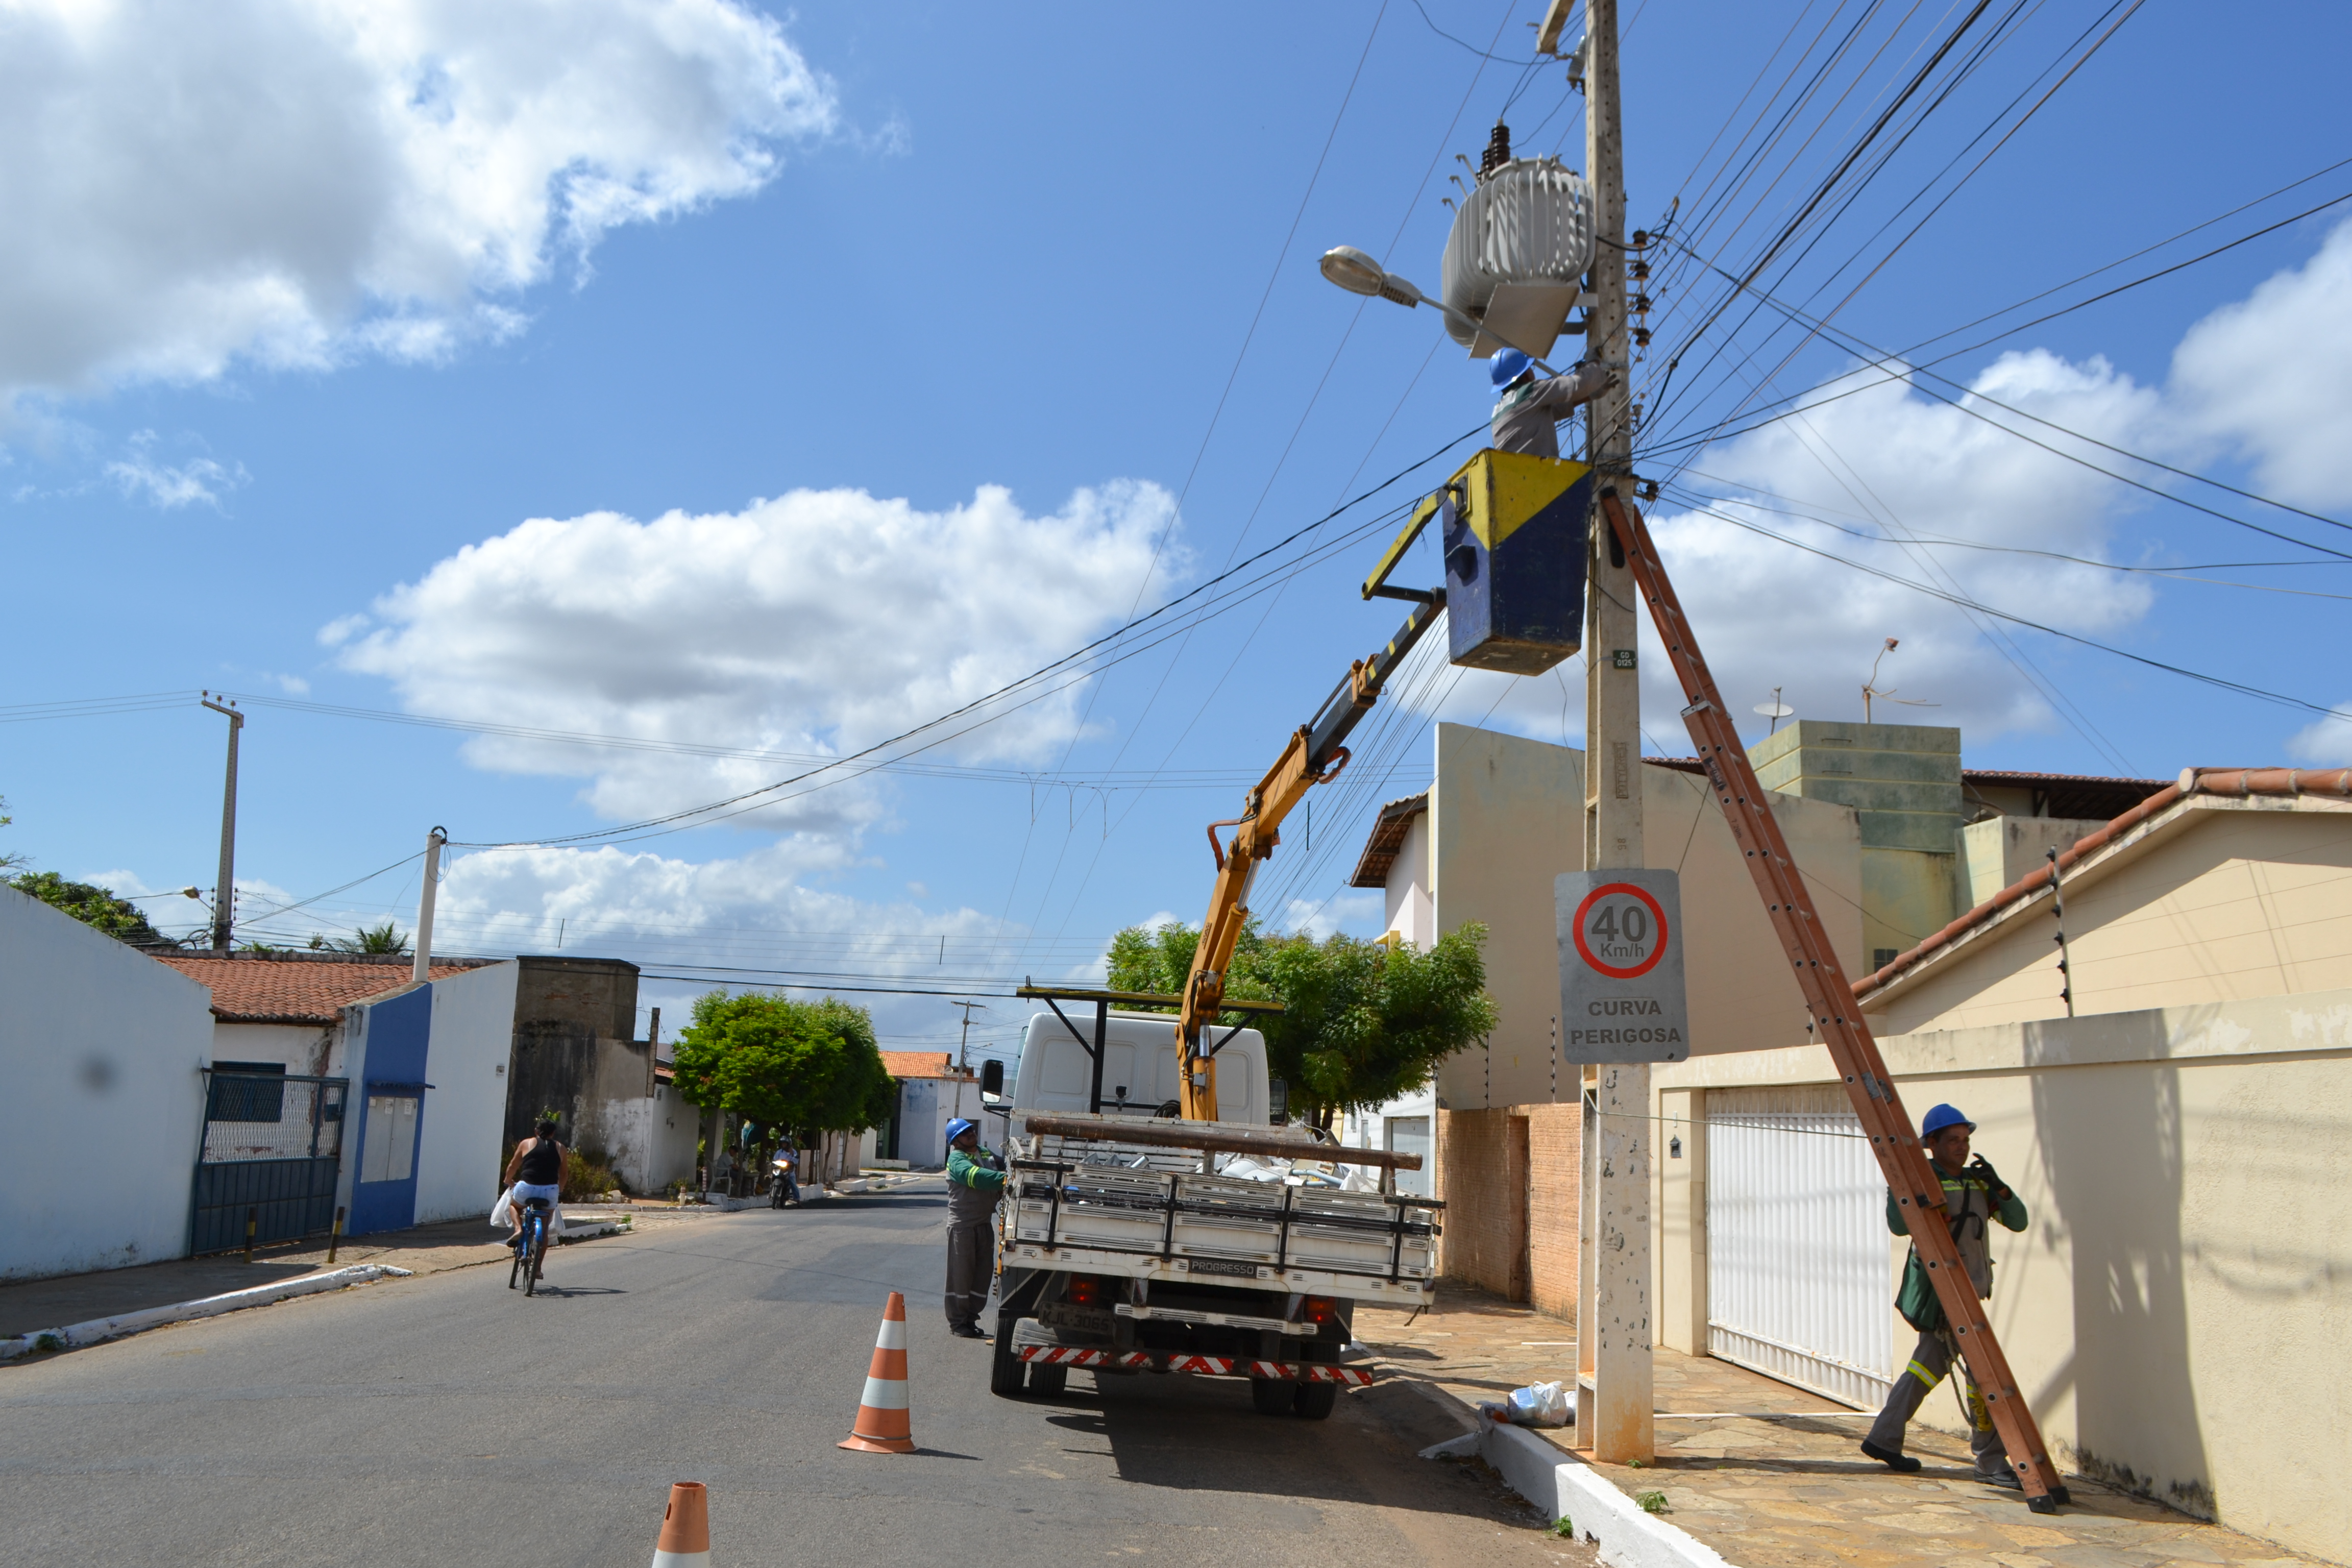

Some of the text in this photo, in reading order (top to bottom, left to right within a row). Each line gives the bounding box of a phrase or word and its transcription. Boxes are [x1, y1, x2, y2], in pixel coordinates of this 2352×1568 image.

[1591, 905, 1647, 942] 40
[1600, 943, 1645, 958] Km/h
[1588, 1000, 1662, 1016] CURVA
[1571, 1027, 1682, 1045] PERIGOSA
[1191, 1261, 1255, 1275] PROGRESSO
